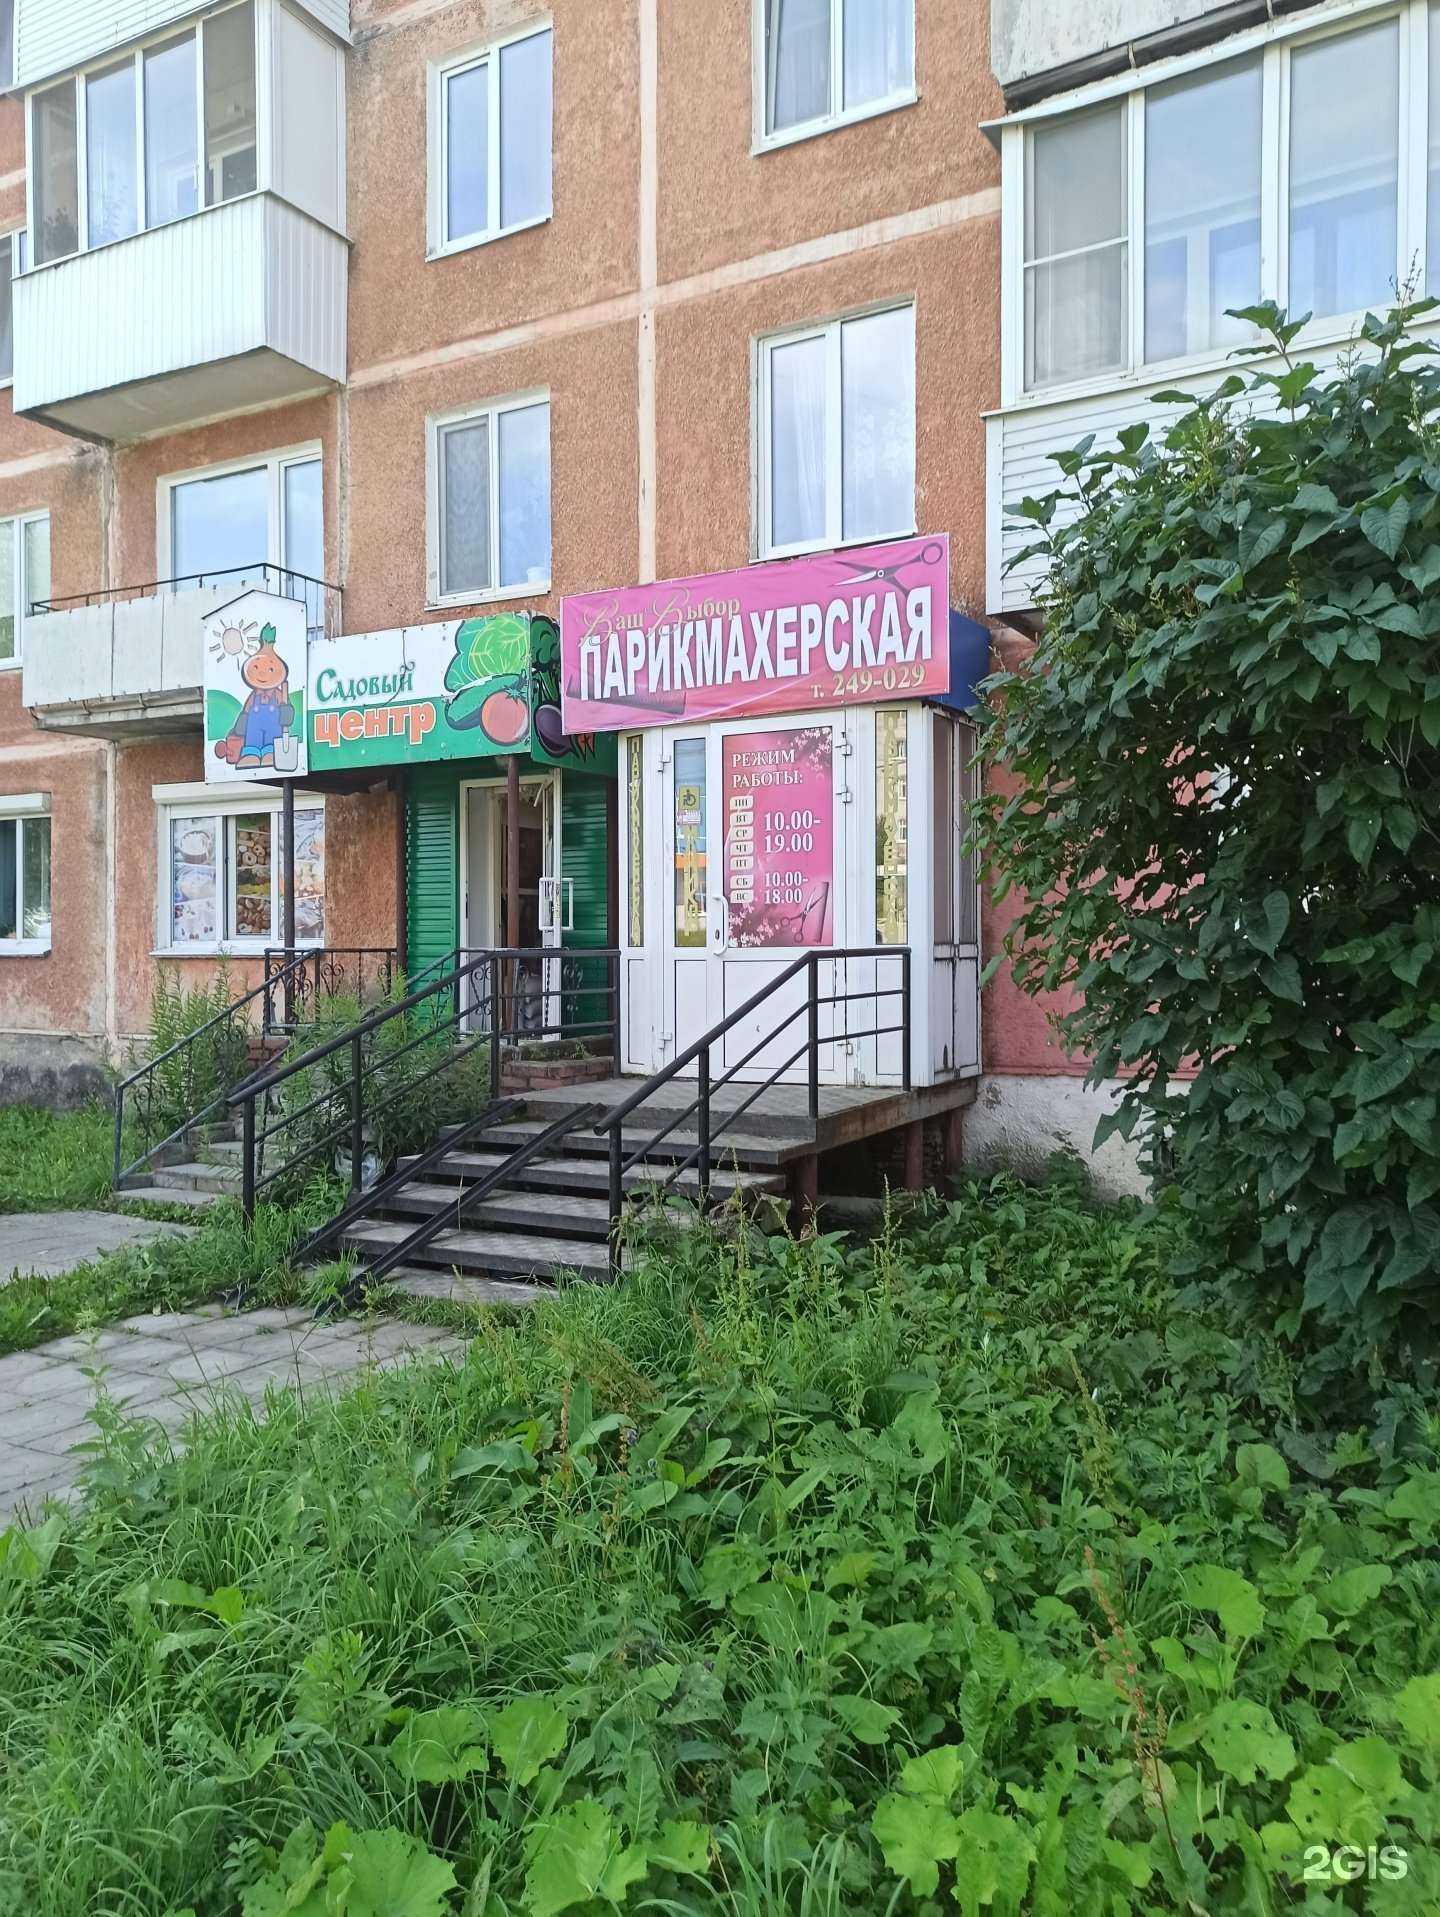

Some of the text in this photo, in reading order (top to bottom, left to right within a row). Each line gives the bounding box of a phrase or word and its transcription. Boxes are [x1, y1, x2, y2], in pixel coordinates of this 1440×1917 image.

[579, 586, 932, 701] ПАРИКМАХЕРСКАЯ
[316, 661, 416, 702] Садовый
[832, 663, 926, 697] 249-029
[314, 702, 437, 748] центр
[732, 749, 796, 768] РЕЖИМ
[732, 770, 804, 788] РАБОТЫ:
[764, 810, 822, 831] 10.00-
[736, 829, 748, 838] СР
[764, 832, 813, 853] 19.00
[764, 871, 809, 887] 10.00-
[764, 888, 803, 904] 18.00
